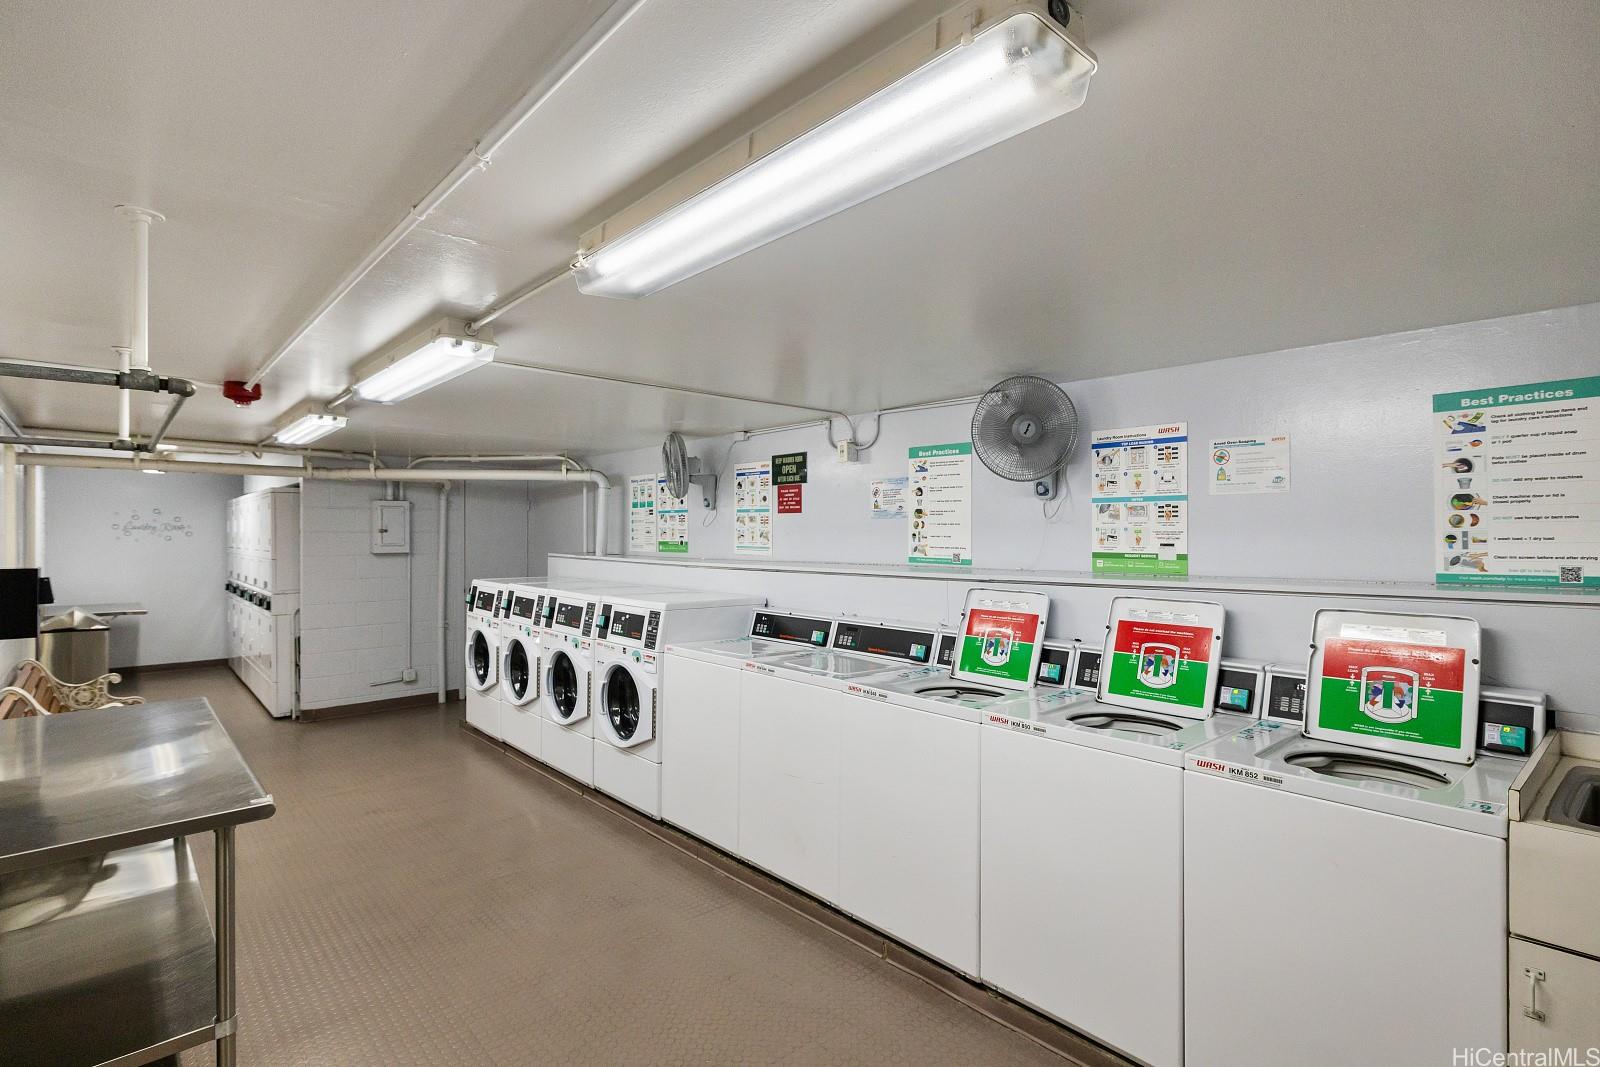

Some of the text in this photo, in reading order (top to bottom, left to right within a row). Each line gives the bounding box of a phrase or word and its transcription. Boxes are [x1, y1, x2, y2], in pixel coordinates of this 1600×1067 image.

[1461, 389, 1574, 407] Best Practices
[1158, 426, 1179, 434] WASH
[782, 465, 796, 474] OPEN
[990, 716, 1008, 724] WASH
[1197, 760, 1258, 779] WASH IKM 852
